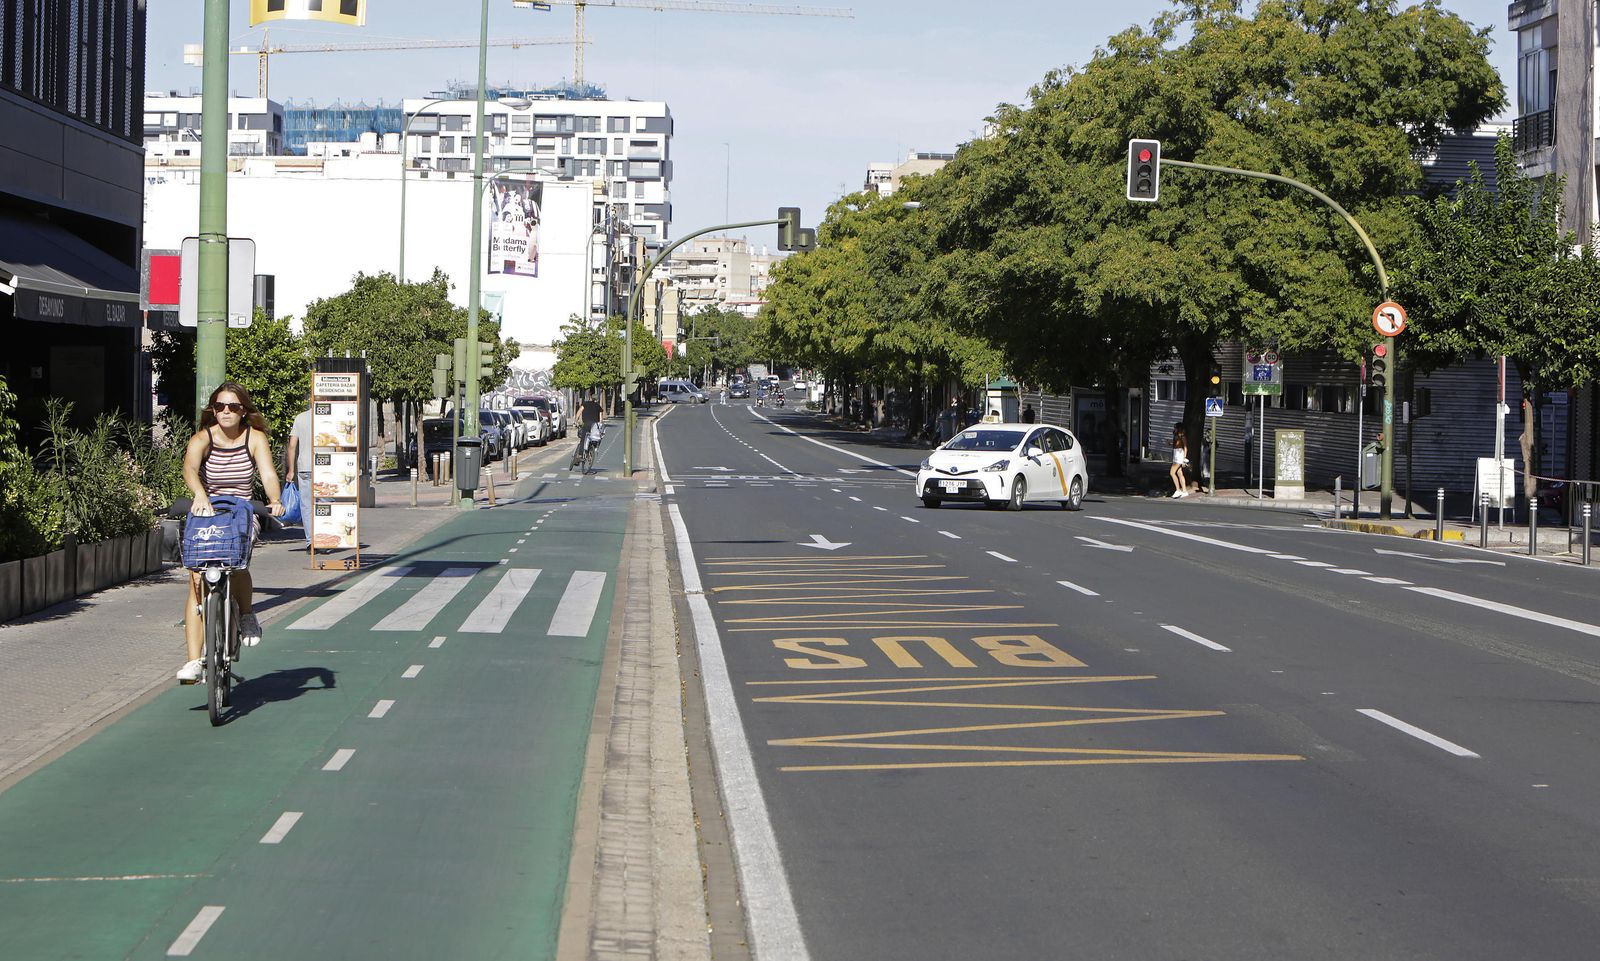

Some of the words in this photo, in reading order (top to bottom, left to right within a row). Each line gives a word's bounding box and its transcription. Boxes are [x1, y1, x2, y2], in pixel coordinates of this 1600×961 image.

[493, 236, 528, 246] Mdama
[38, 295, 65, 318] DESAYUNOS
[112, 303, 126, 322] BAZAR
[772, 635, 1089, 669] BUS
